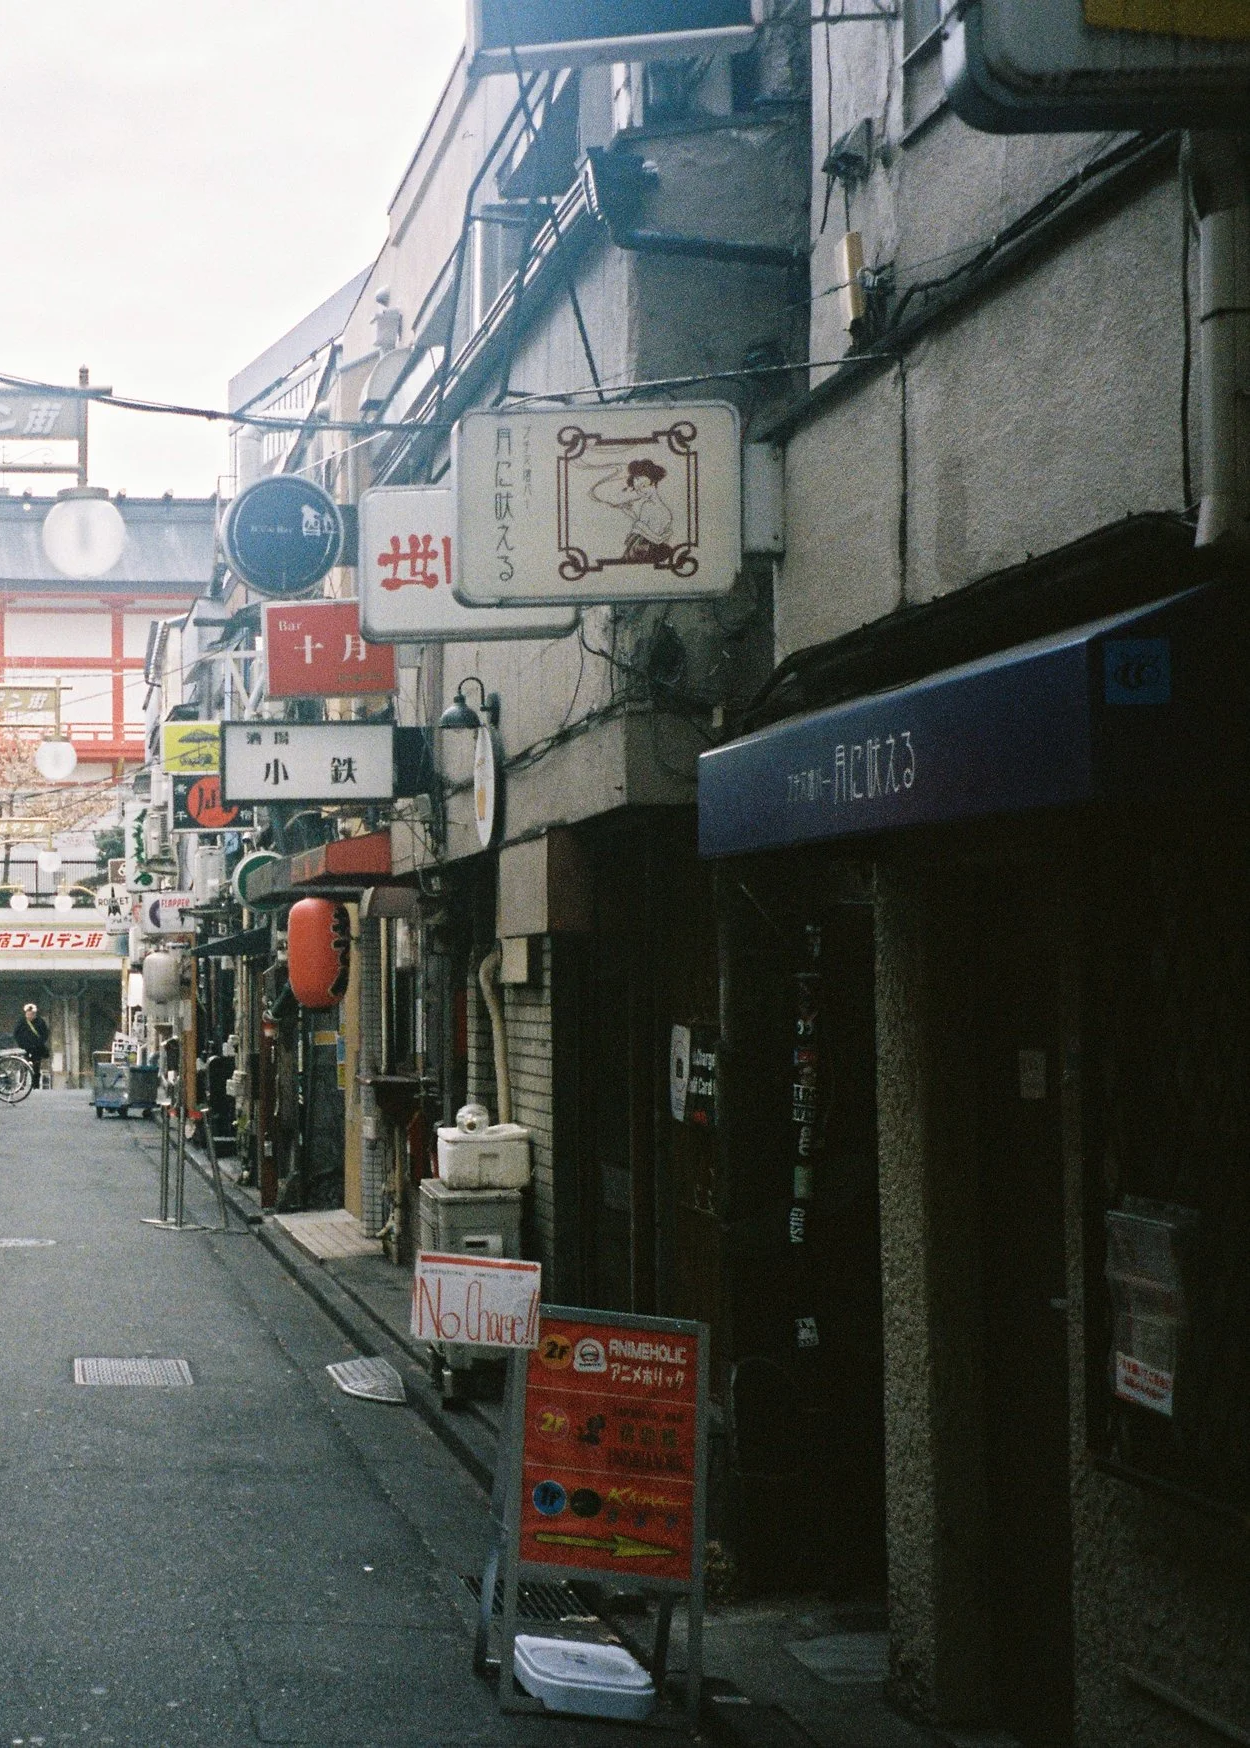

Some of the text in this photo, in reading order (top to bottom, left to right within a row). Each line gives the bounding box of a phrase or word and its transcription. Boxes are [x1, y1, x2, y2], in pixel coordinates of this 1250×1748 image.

[494, 427, 515, 582] 月に吠える
[377, 534, 452, 590] 世
[278, 621, 302, 631] Bar
[263, 757, 357, 785] 小鉄
[833, 731, 915, 804] 月に吠える
[418, 1276, 461, 1340] No
[608, 1338, 688, 1365] ANIMEHOLIC
[609, 1362, 686, 1389] アニメホリック
